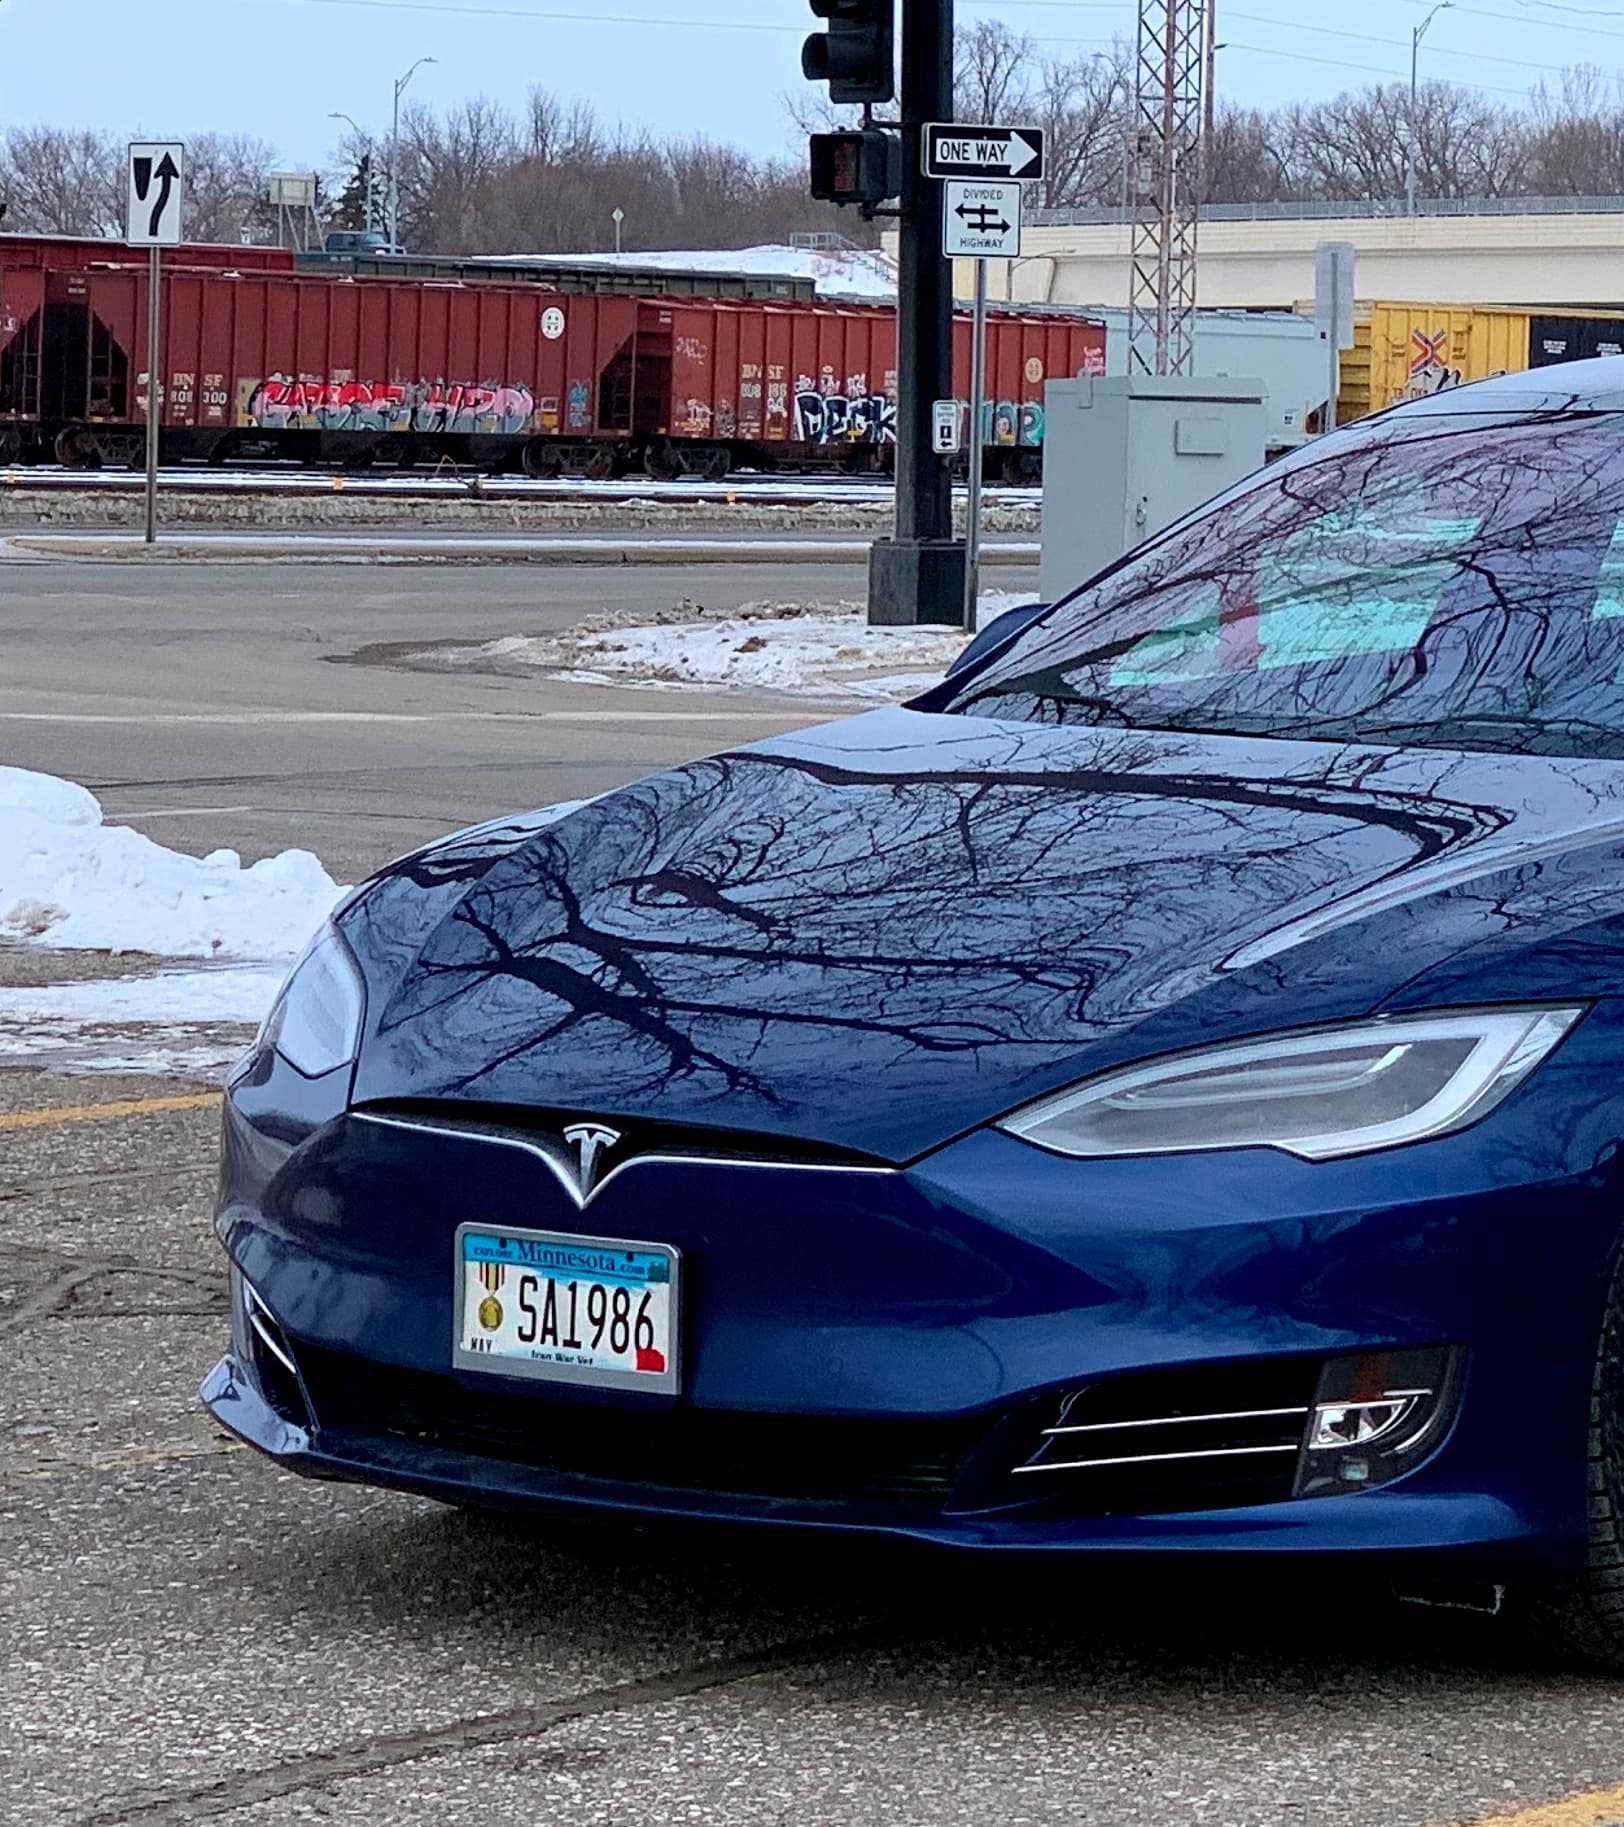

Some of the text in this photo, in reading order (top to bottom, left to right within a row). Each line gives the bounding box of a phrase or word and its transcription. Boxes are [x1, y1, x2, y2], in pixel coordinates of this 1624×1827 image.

[940, 141, 1008, 162] ONE WAY
[963, 188, 1004, 200] DIVIDED
[960, 237, 1005, 249] HIGHWAY
[517, 1275, 654, 1354] SA1986
[471, 1337, 493, 1352] MAY
